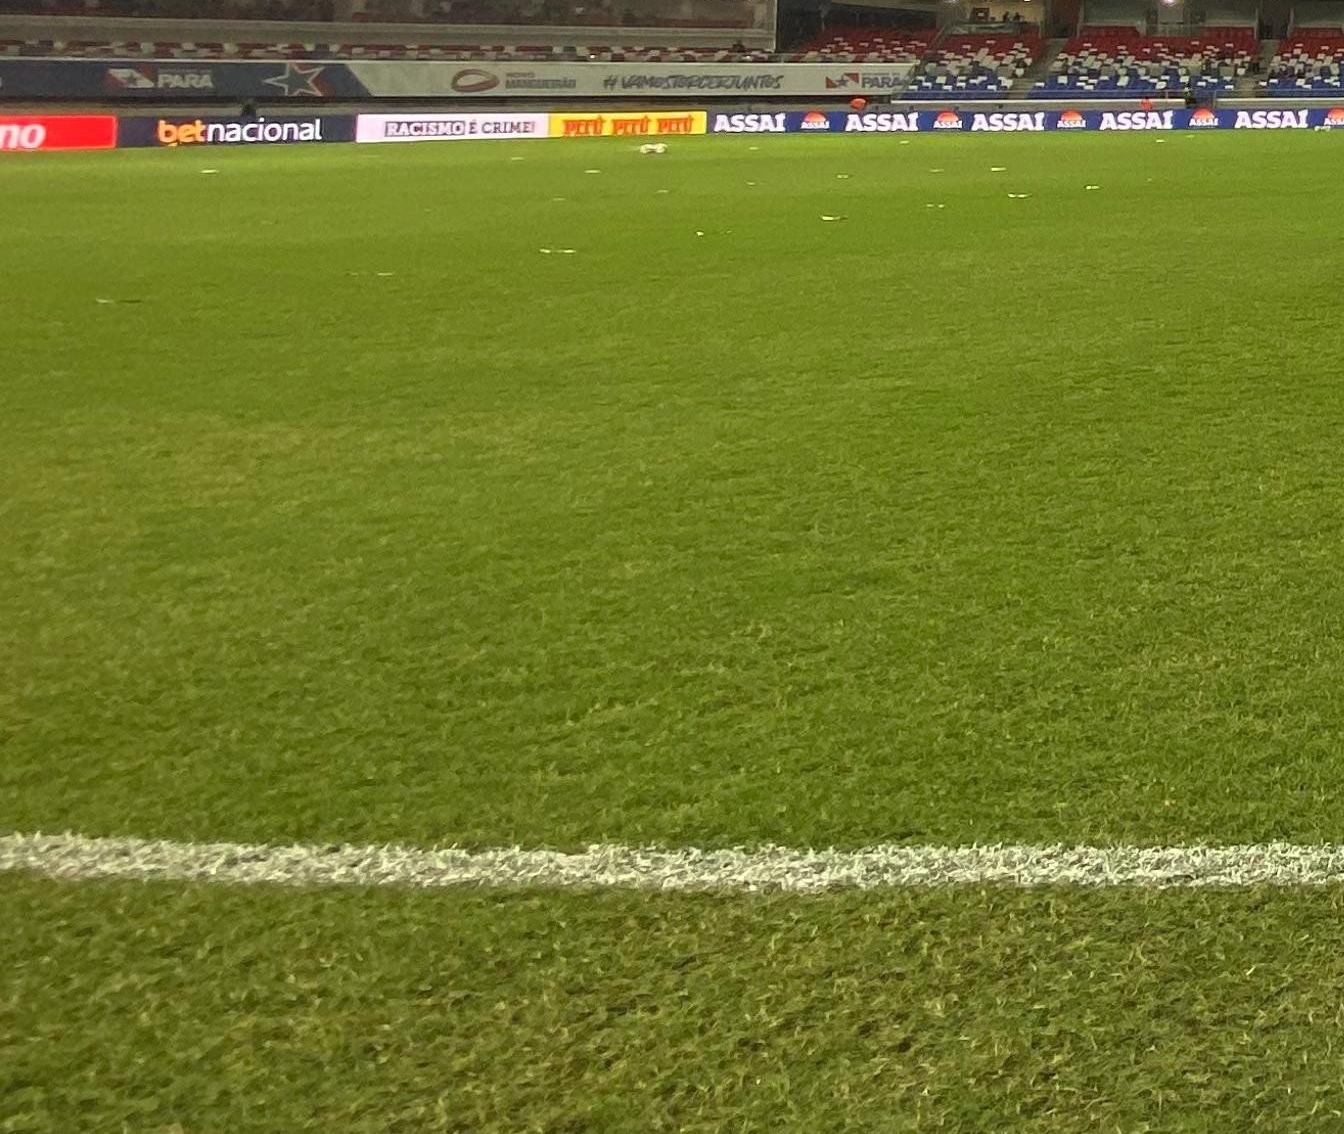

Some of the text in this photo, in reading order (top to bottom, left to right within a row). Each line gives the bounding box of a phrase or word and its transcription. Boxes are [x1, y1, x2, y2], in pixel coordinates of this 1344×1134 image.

[158, 118, 323, 145] betnacional
[385, 120, 465, 138] RACISMO
[469, 118, 478, 135] É
